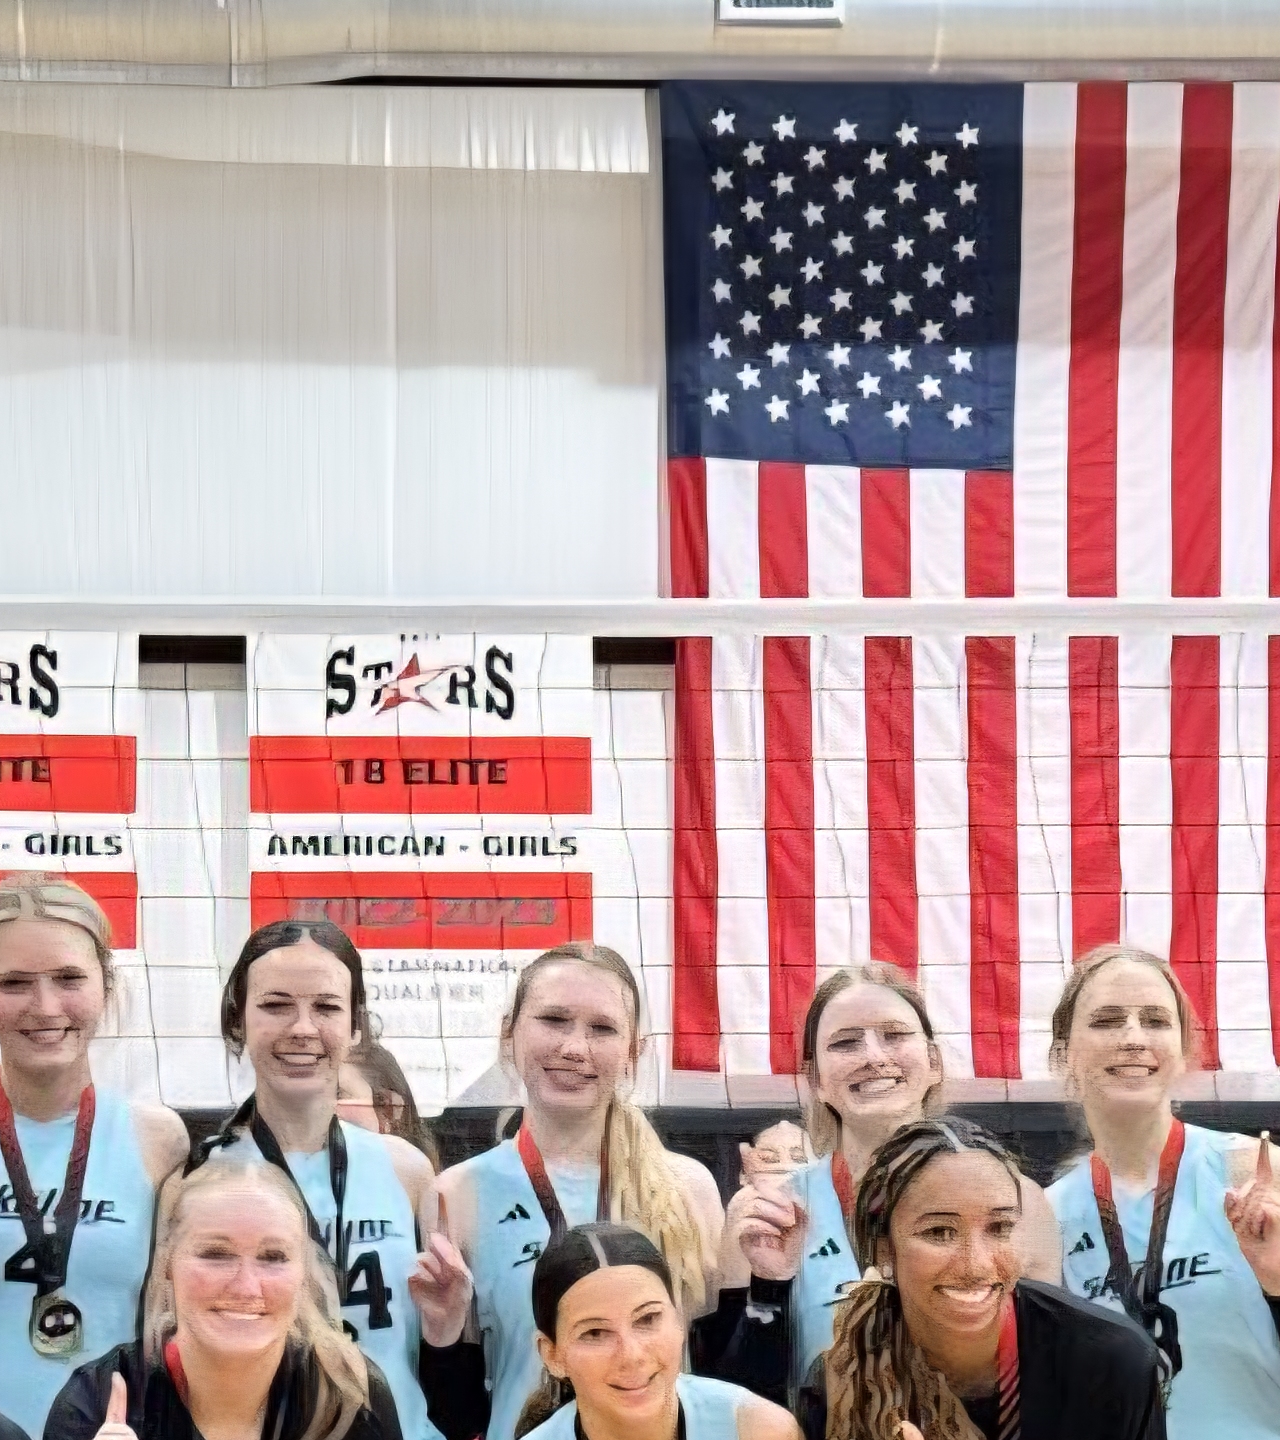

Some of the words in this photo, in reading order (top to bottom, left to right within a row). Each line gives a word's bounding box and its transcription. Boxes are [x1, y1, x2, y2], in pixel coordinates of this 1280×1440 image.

[325, 645, 515, 721] STARS
[336, 758, 385, 785] 18
[403, 758, 508, 785] ELITE
[25, 833, 123, 856] GIRLS
[267, 834, 445, 857] AMERICAN
[483, 835, 578, 857] GIRLS
